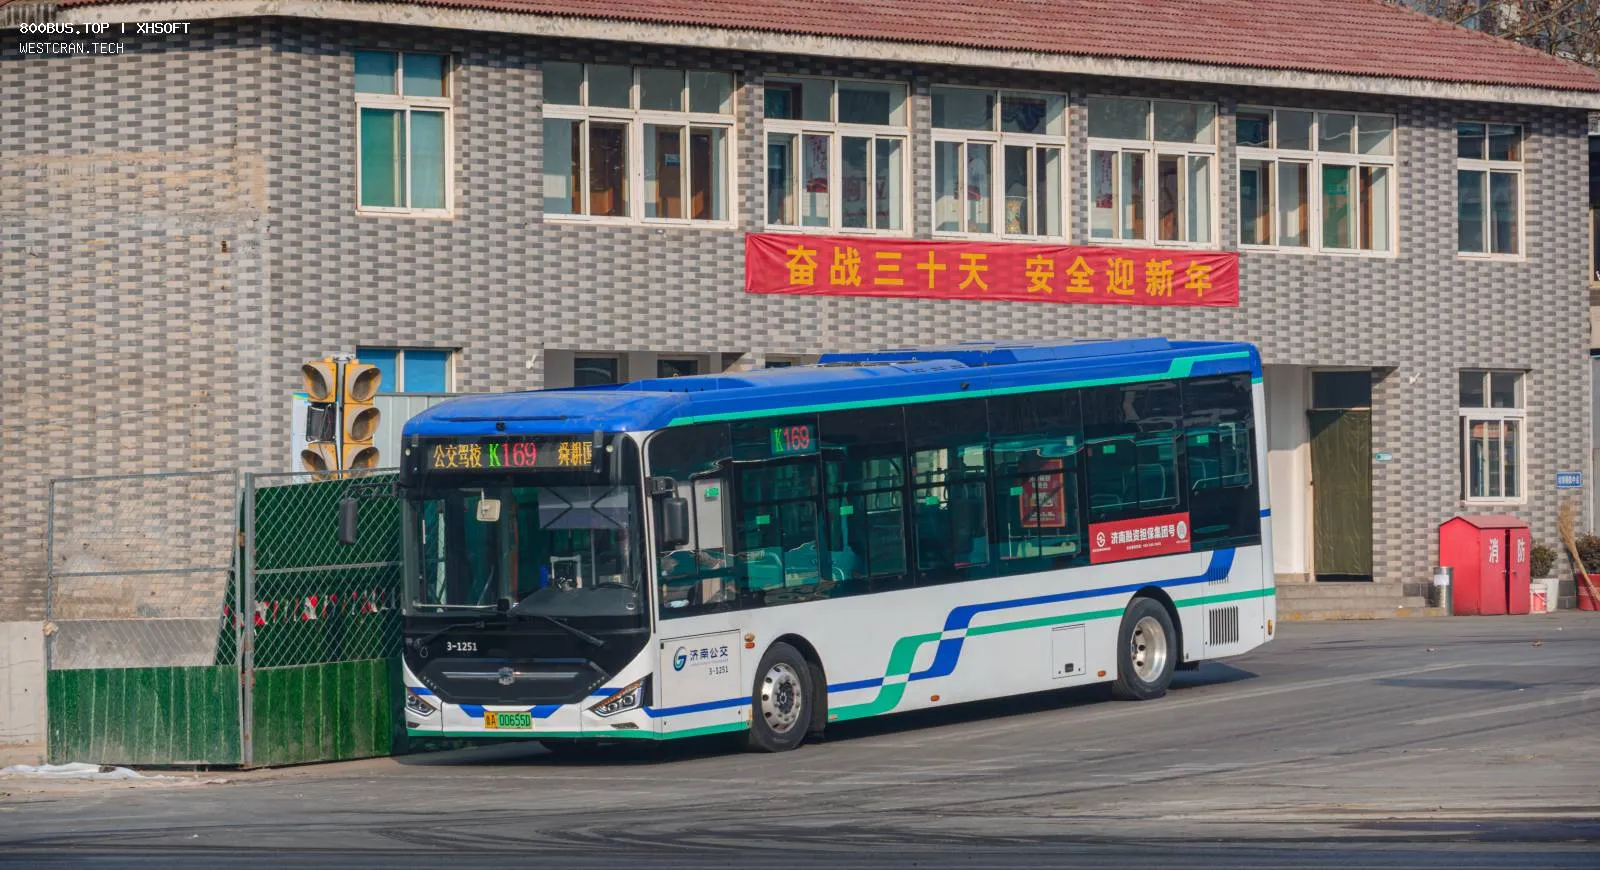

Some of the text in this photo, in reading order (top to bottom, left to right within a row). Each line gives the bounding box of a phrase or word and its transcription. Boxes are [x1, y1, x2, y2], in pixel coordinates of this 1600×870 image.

[785, 245, 1213, 298] 奋战三十天 安全迎新年
[774, 425, 809, 452] K169
[433, 443, 483, 468] 公交驾校
[488, 442, 537, 468] K169
[446, 642, 478, 652] 3-1251
[689, 646, 729, 661] 济南公交
[708, 665, 729, 676] 3-1251
